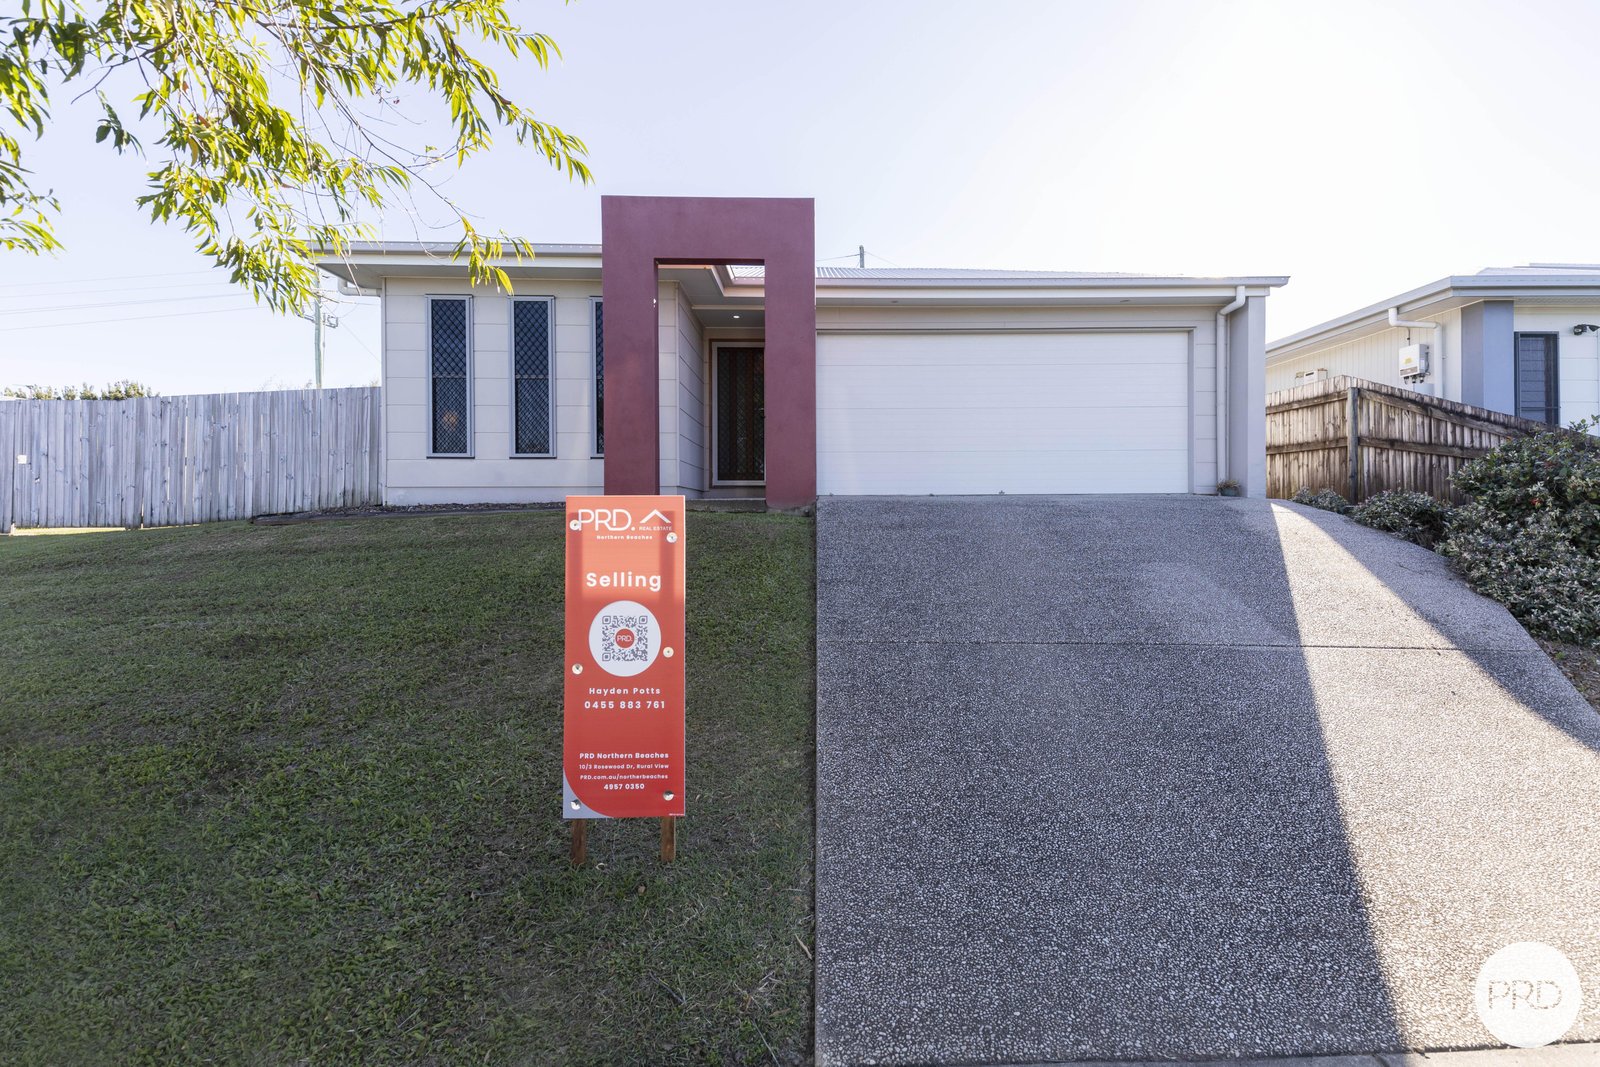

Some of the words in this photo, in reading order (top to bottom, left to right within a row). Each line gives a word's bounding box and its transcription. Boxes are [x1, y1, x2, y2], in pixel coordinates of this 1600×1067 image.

[586, 571, 661, 592] Selling
[589, 687, 629, 696] Hayden
[633, 687, 661, 695] Potts
[584, 700, 615, 709] 0455
[620, 700, 641, 709] 883
[646, 700, 665, 709] 761
